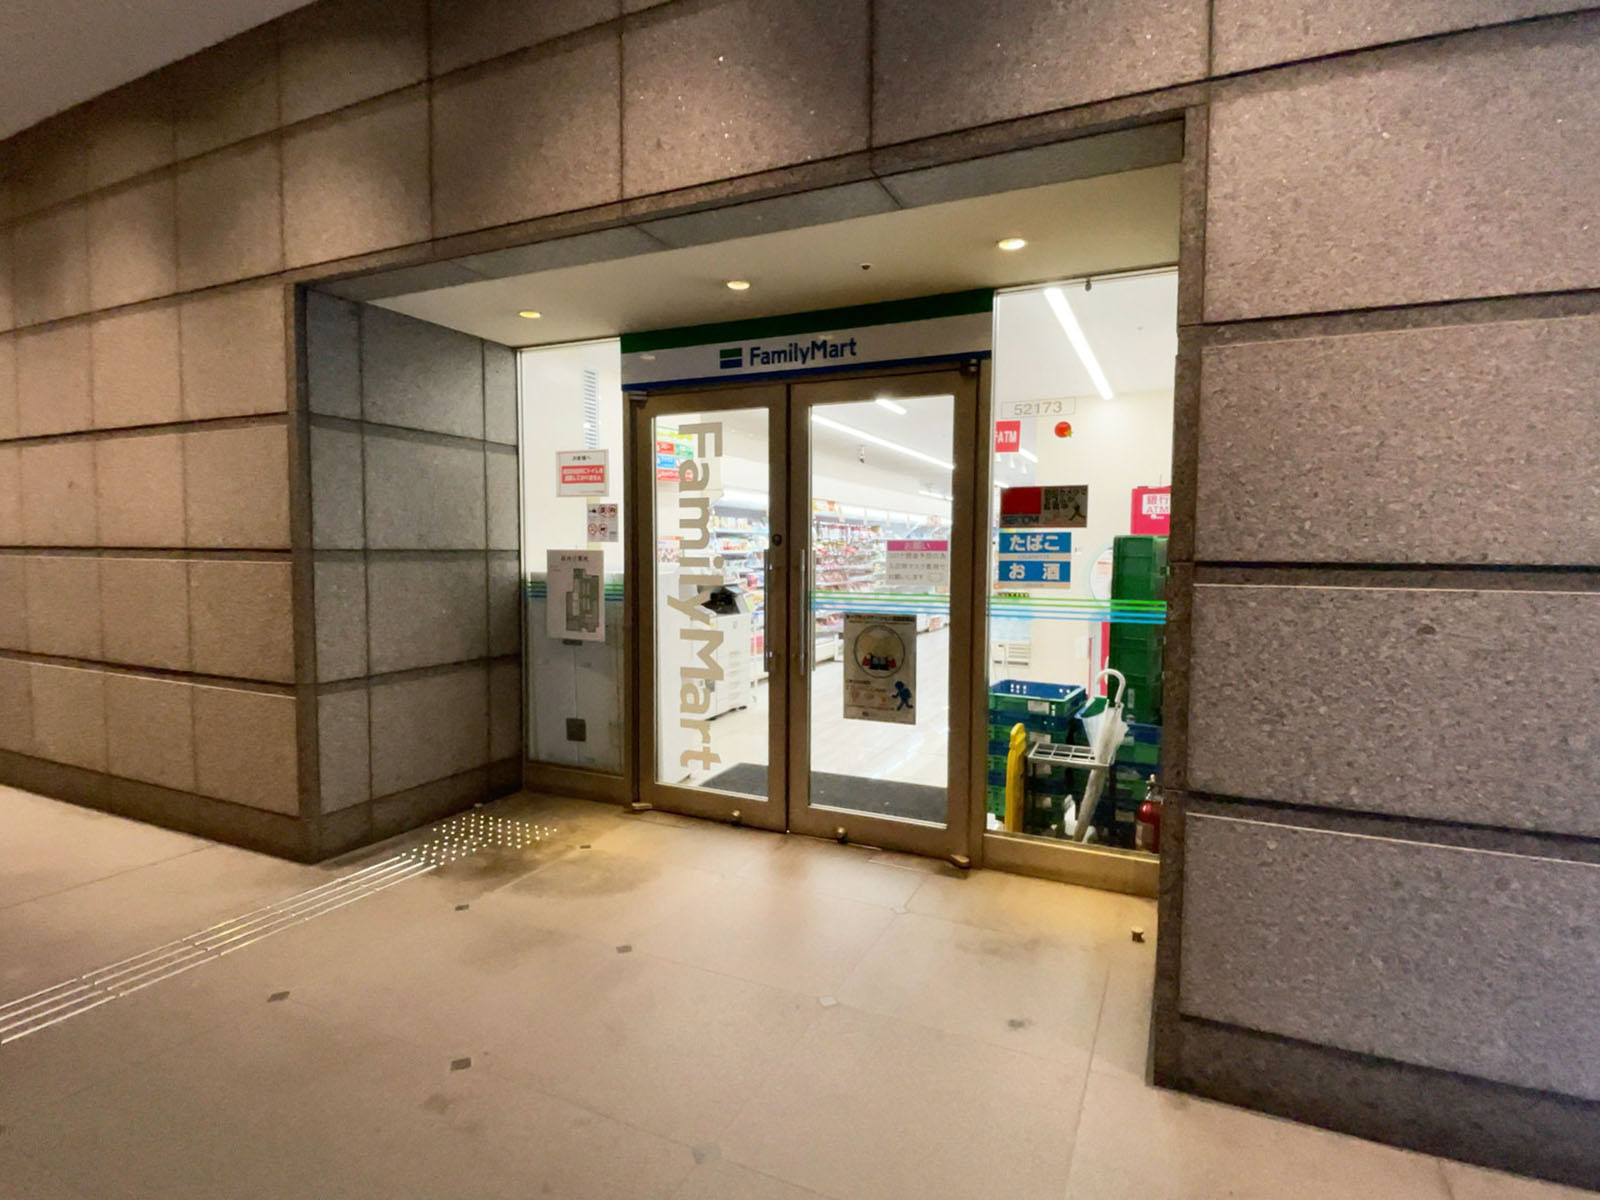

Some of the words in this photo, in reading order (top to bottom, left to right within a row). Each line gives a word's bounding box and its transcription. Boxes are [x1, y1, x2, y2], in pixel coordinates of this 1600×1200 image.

[750, 338, 857, 366] FamilyMart
[1014, 401, 1063, 416] 52173
[1146, 505, 1169, 513] ATM
[1009, 534, 1060, 551] たばこ
[667, 422, 724, 771] FamilyMart
